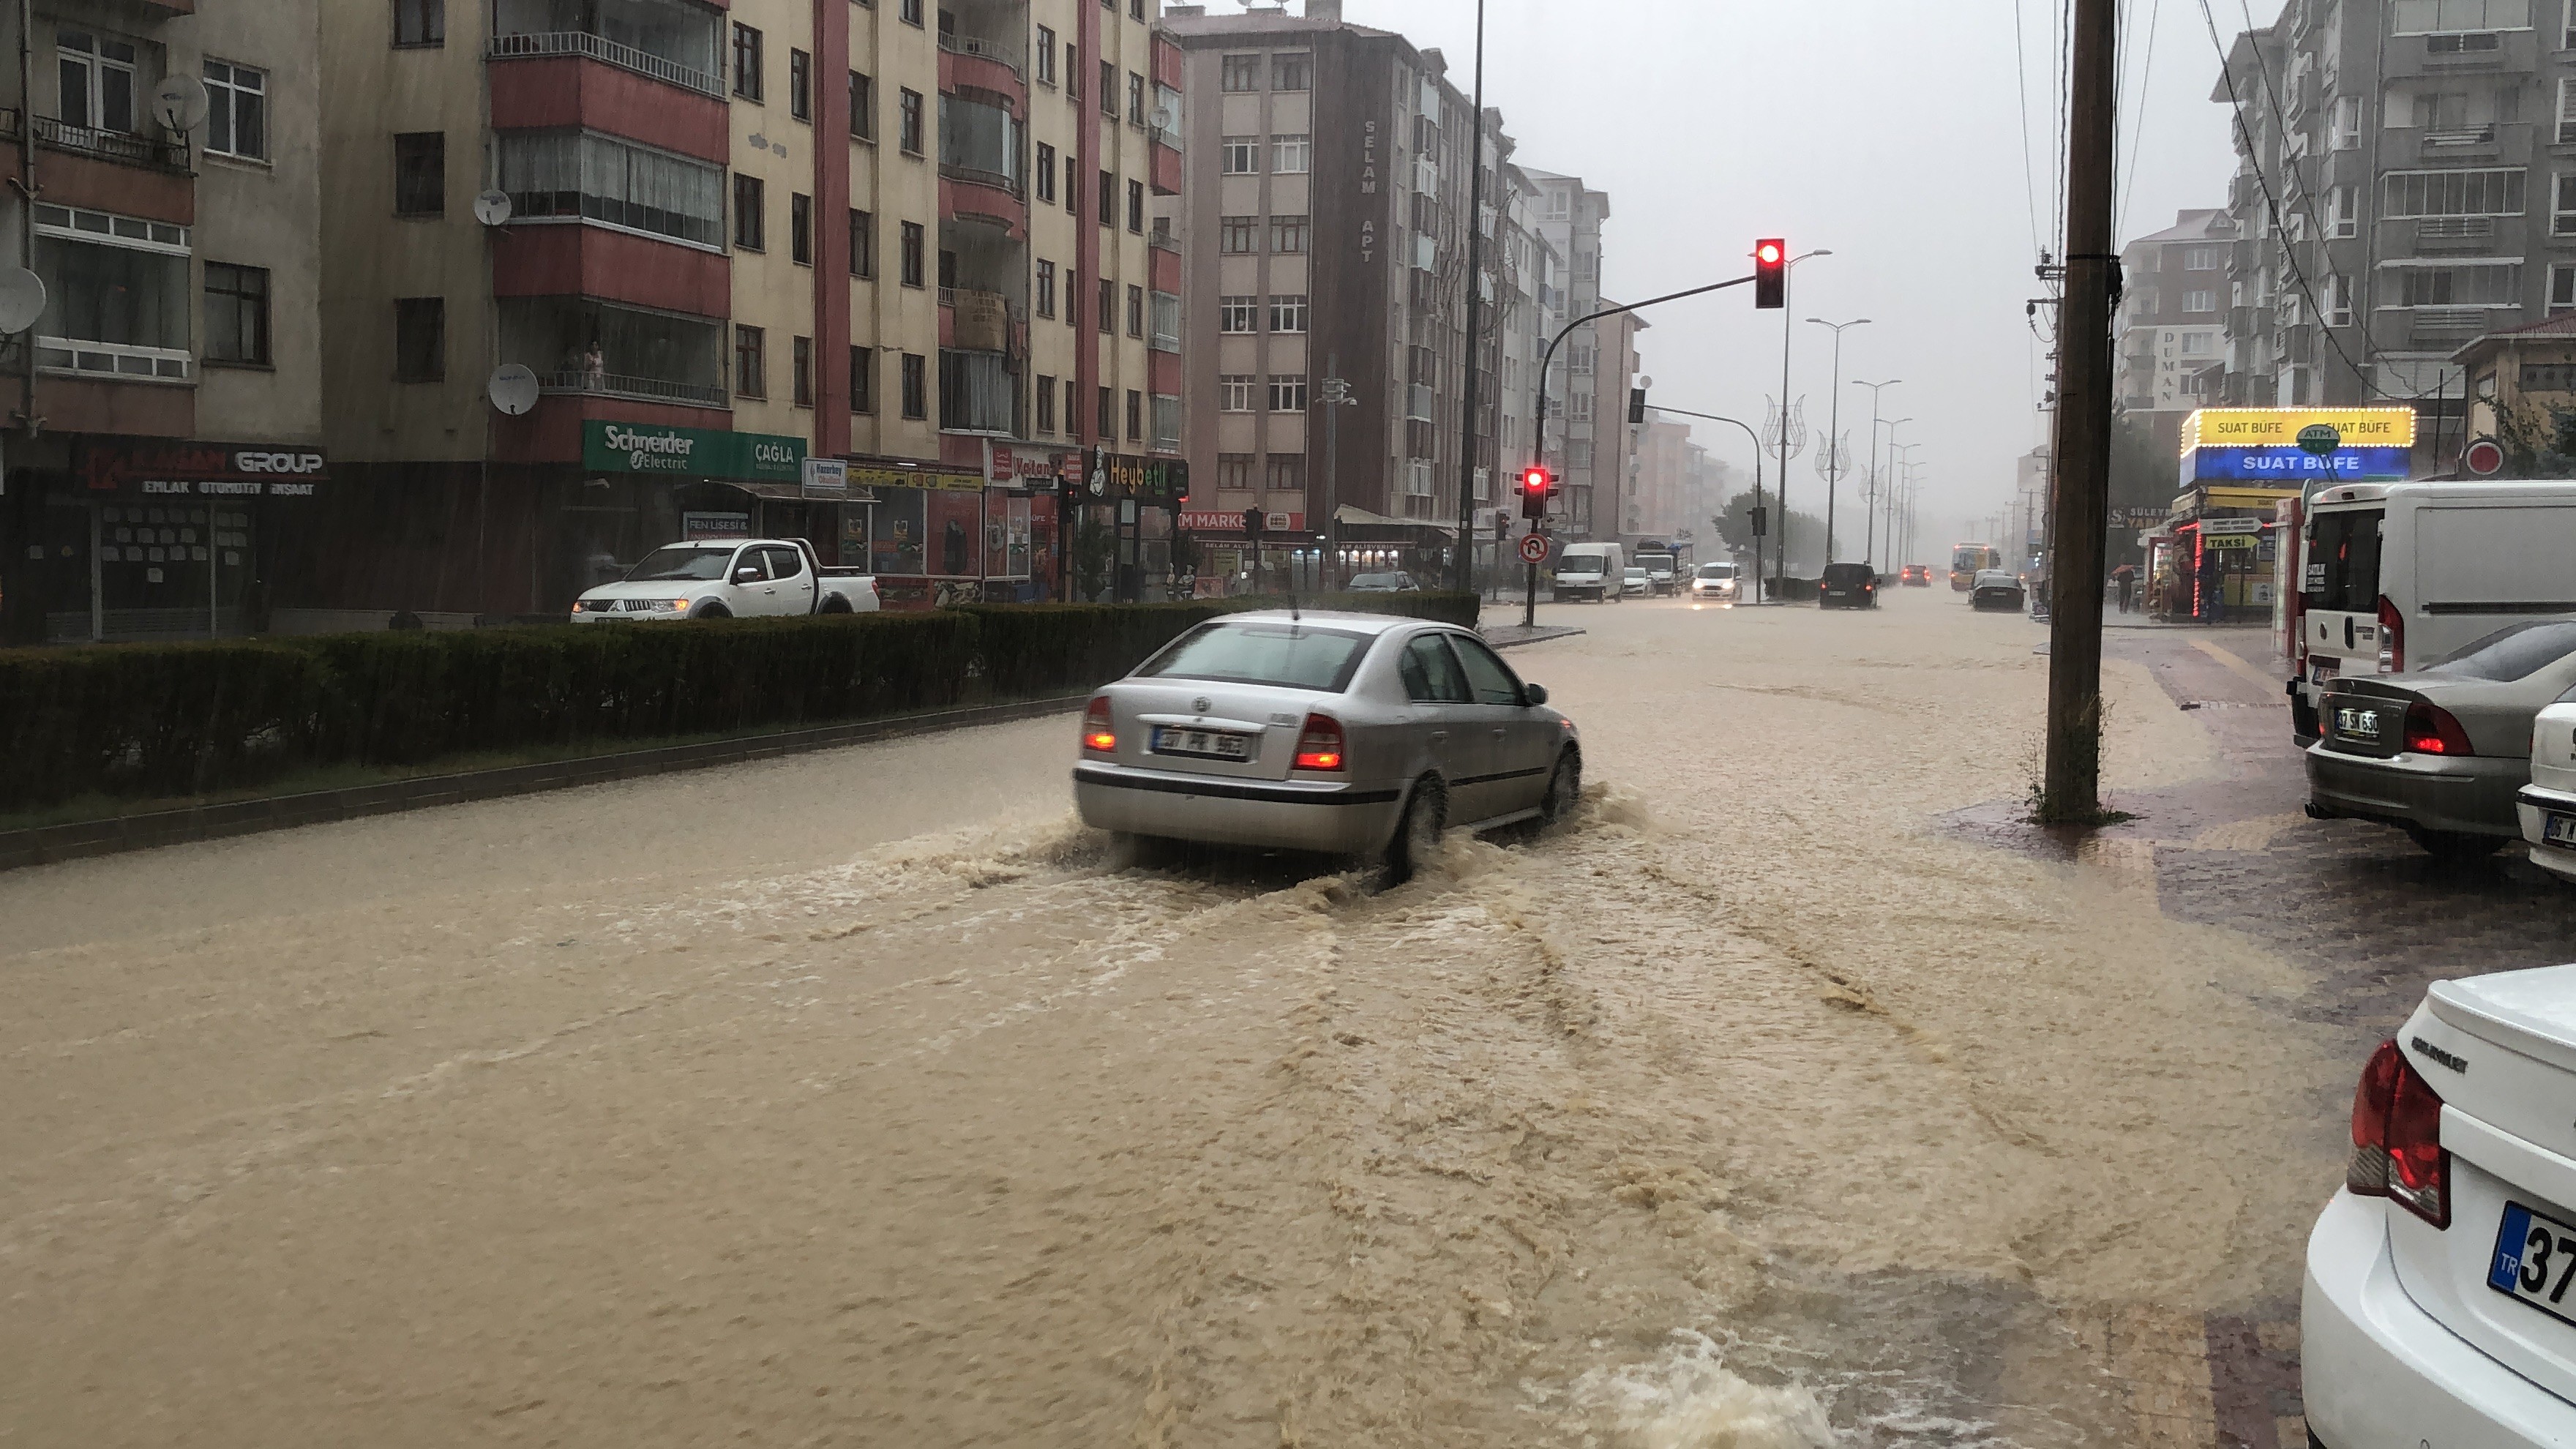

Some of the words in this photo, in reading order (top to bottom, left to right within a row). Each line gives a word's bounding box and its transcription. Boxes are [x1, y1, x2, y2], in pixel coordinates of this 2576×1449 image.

[1362, 121, 1375, 194] SELAM
[1361, 220, 1374, 263] APT
[2162, 332, 2175, 402] DUMAN
[2217, 422, 2249, 433] SUAT
[2251, 419, 2283, 433] BÜFE
[2304, 430, 2331, 438] ATM
[2326, 422, 2356, 433] UAT
[2359, 419, 2391, 433] BÜFE
[604, 424, 694, 455] Schneider
[755, 441, 794, 463] ÇAĞLA
[234, 451, 323, 474] GROUP
[643, 454, 687, 471] Electric
[2242, 456, 2299, 470] SUAT
[1110, 456, 1167, 495] Heybetli
[141, 480, 189, 494] EMLAK
[689, 520, 709, 530] FEN
[710, 518, 738, 531] LİSESİ
[740, 521, 747, 531] &
[1197, 514, 1247, 528] MARKE
[2209, 536, 2245, 547] TAKSİ
[2362, 714, 2378, 732] 630
[2501, 1252, 2518, 1276] TR
[2520, 1227, 2576, 1303] 37
